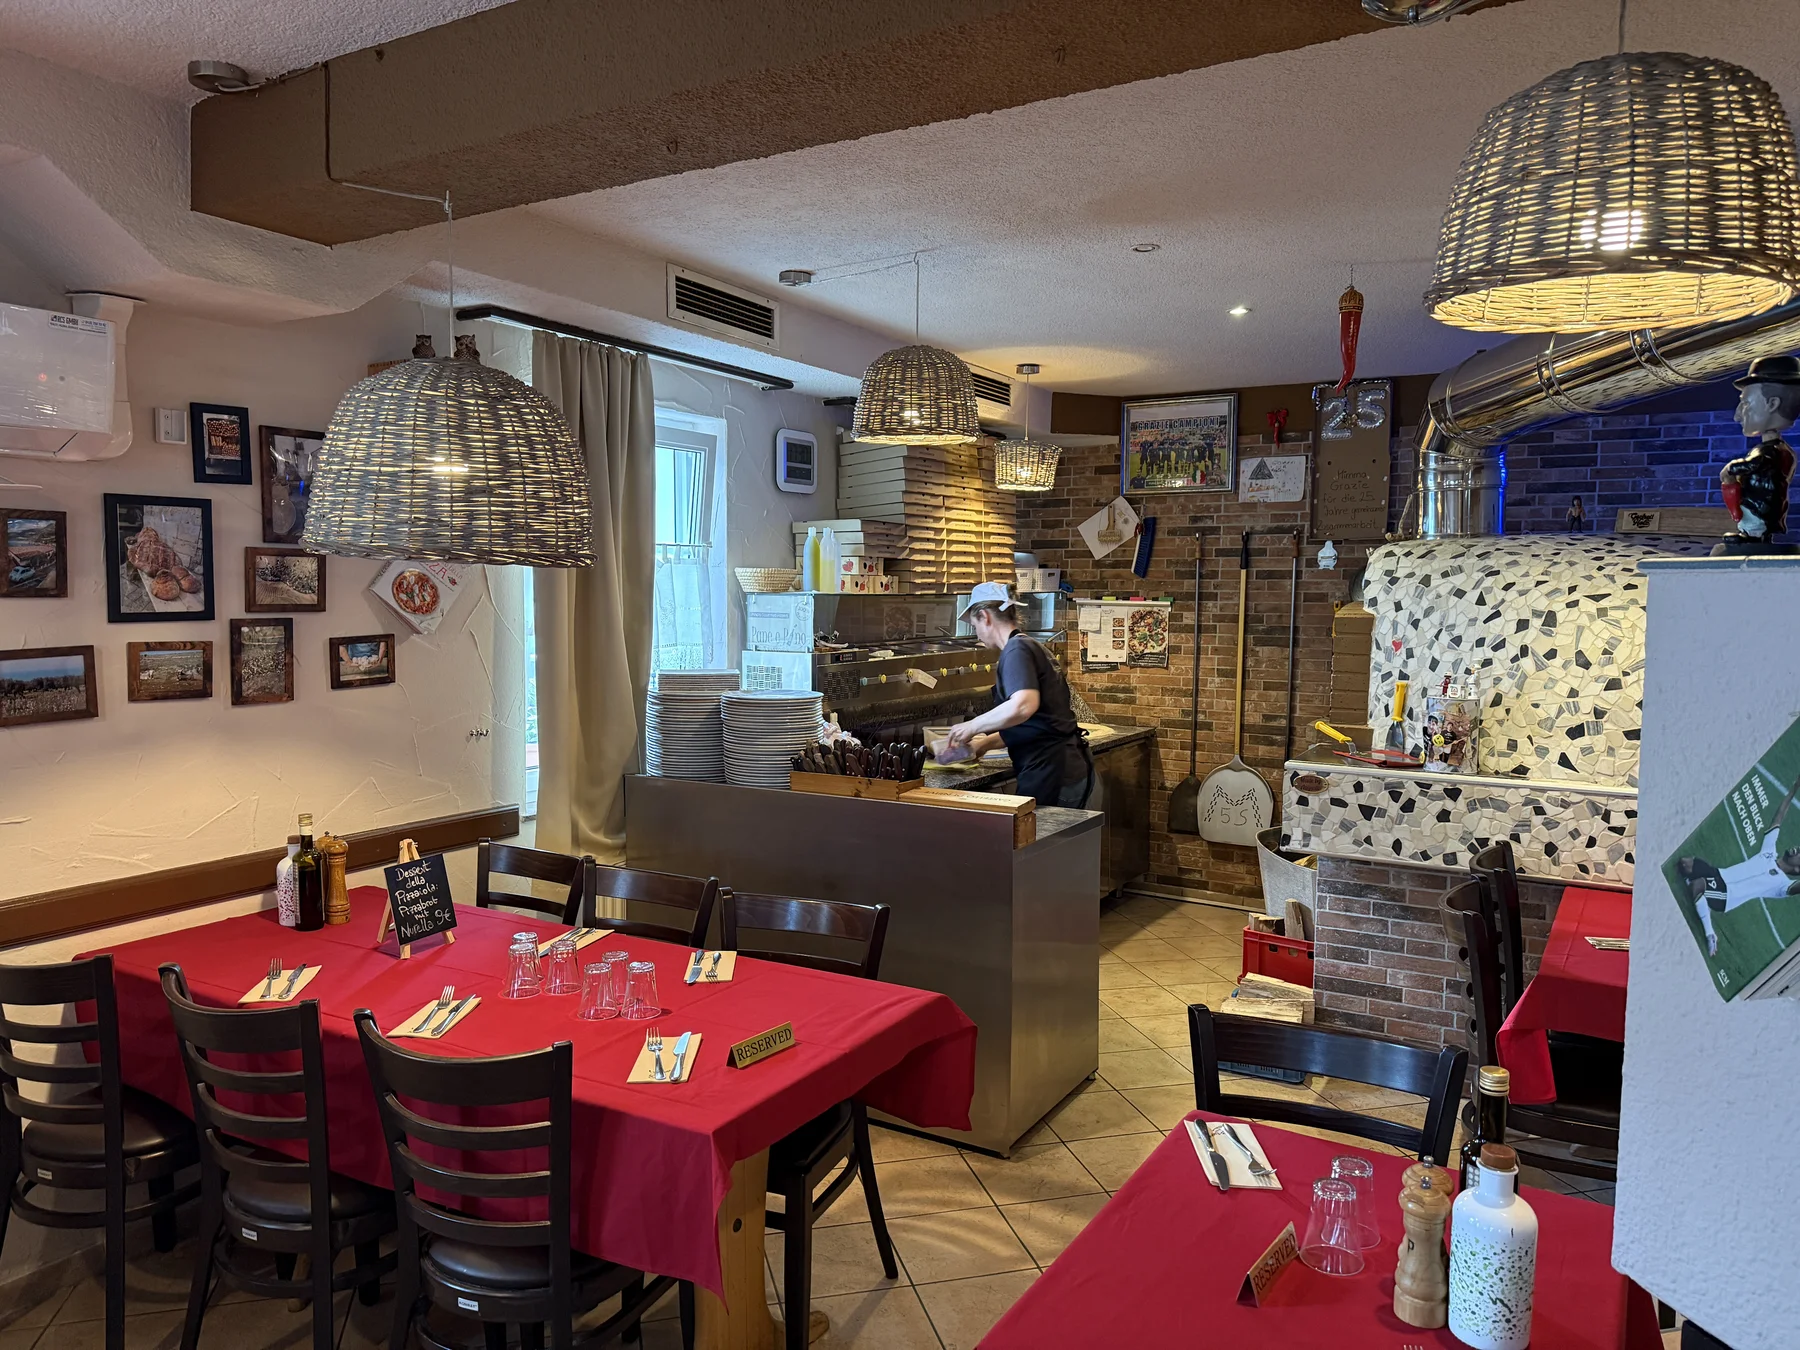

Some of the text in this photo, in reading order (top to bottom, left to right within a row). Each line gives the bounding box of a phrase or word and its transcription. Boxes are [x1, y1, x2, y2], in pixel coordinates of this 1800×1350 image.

[1138, 416, 1220, 431] GRAZIE CAMPIONI
[1321, 389, 1386, 441] 25
[1330, 480, 1370, 491] Grazie
[1341, 493, 1356, 503] die
[1324, 505, 1349, 517] Jahre
[751, 626, 773, 644] Pane
[1751, 774, 1769, 809] IMMER
[1741, 783, 1764, 832] DEN BLICK
[1732, 791, 1757, 847] NACH OBEN
[395, 860, 432, 881] Dessert
[405, 876, 426, 889] della
[1706, 877, 1717, 889] 19
[395, 883, 439, 905] Pizzaiola:
[398, 896, 439, 917] Pizzabrot
[414, 910, 430, 921] mit
[736, 1028, 792, 1062] RESERVED
[1253, 1233, 1296, 1296] RESERVED
